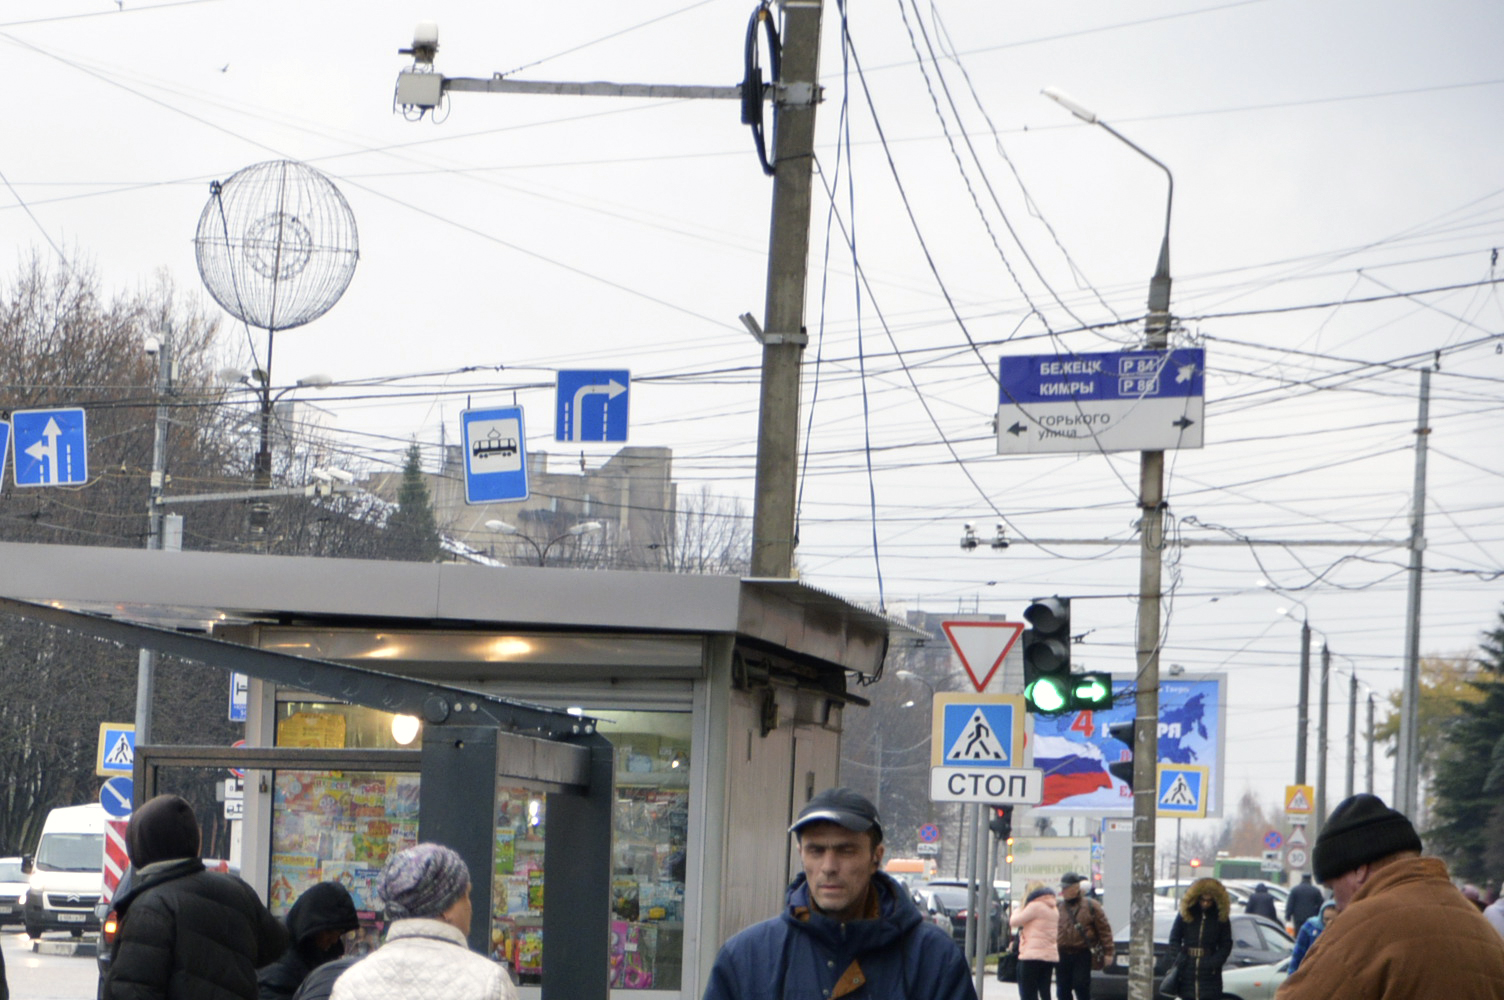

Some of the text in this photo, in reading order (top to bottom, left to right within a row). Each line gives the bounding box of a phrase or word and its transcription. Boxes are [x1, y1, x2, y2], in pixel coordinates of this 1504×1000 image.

[1040, 360, 1153, 375] БЕЖЕЦК Р 84
[1039, 382, 1094, 395] КИМРЫ
[1123, 380, 1133, 392] Р
[1039, 413, 1110, 426] ГОРЬКОГО
[1039, 428, 1077, 440] улица
[1071, 710, 1095, 737] 4
[948, 773, 1026, 797] СТОП
[1291, 853, 1303, 863] 30
